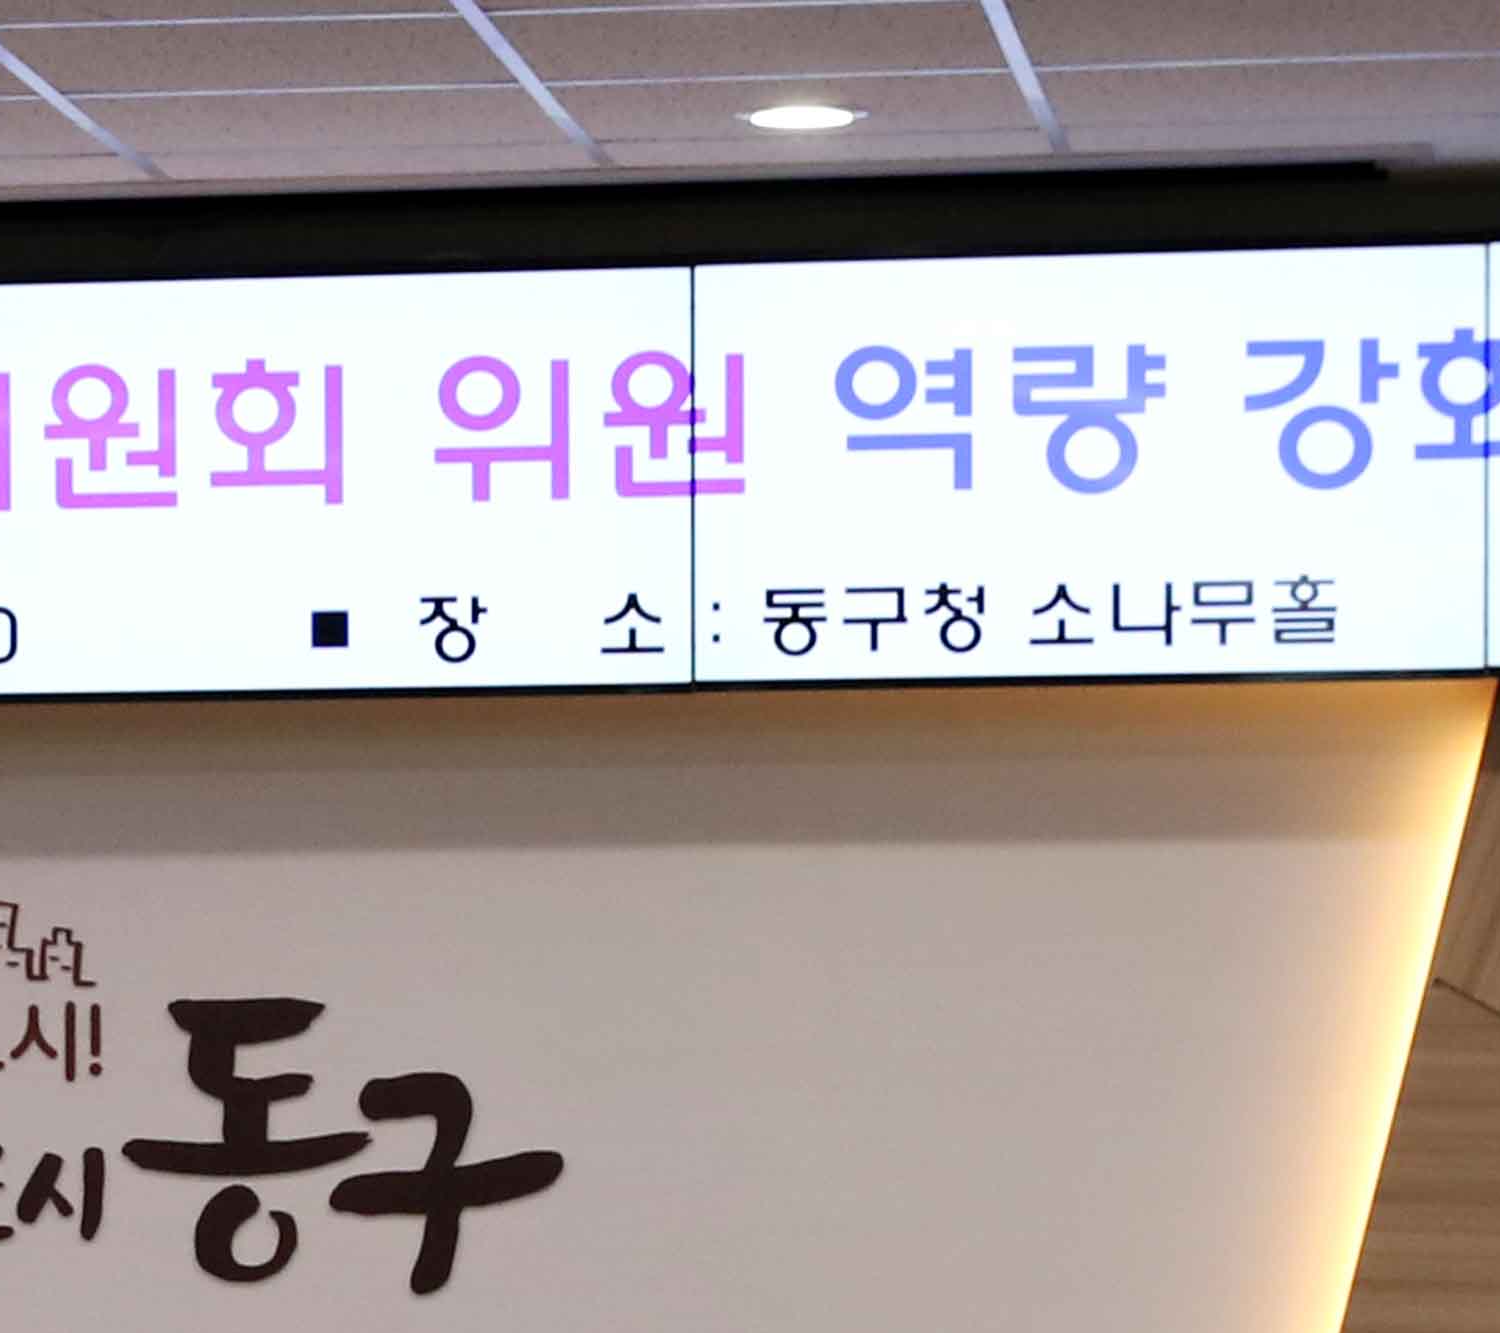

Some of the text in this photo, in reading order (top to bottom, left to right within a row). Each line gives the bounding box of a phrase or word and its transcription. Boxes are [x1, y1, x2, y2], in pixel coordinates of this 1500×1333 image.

[434, 350, 745, 502] 위원
[834, 344, 1166, 494] 역량
[762, 582, 985, 657] 동구청
[1028, 574, 1336, 646] 소나무홀
[119, 995, 566, 1295] 동구
